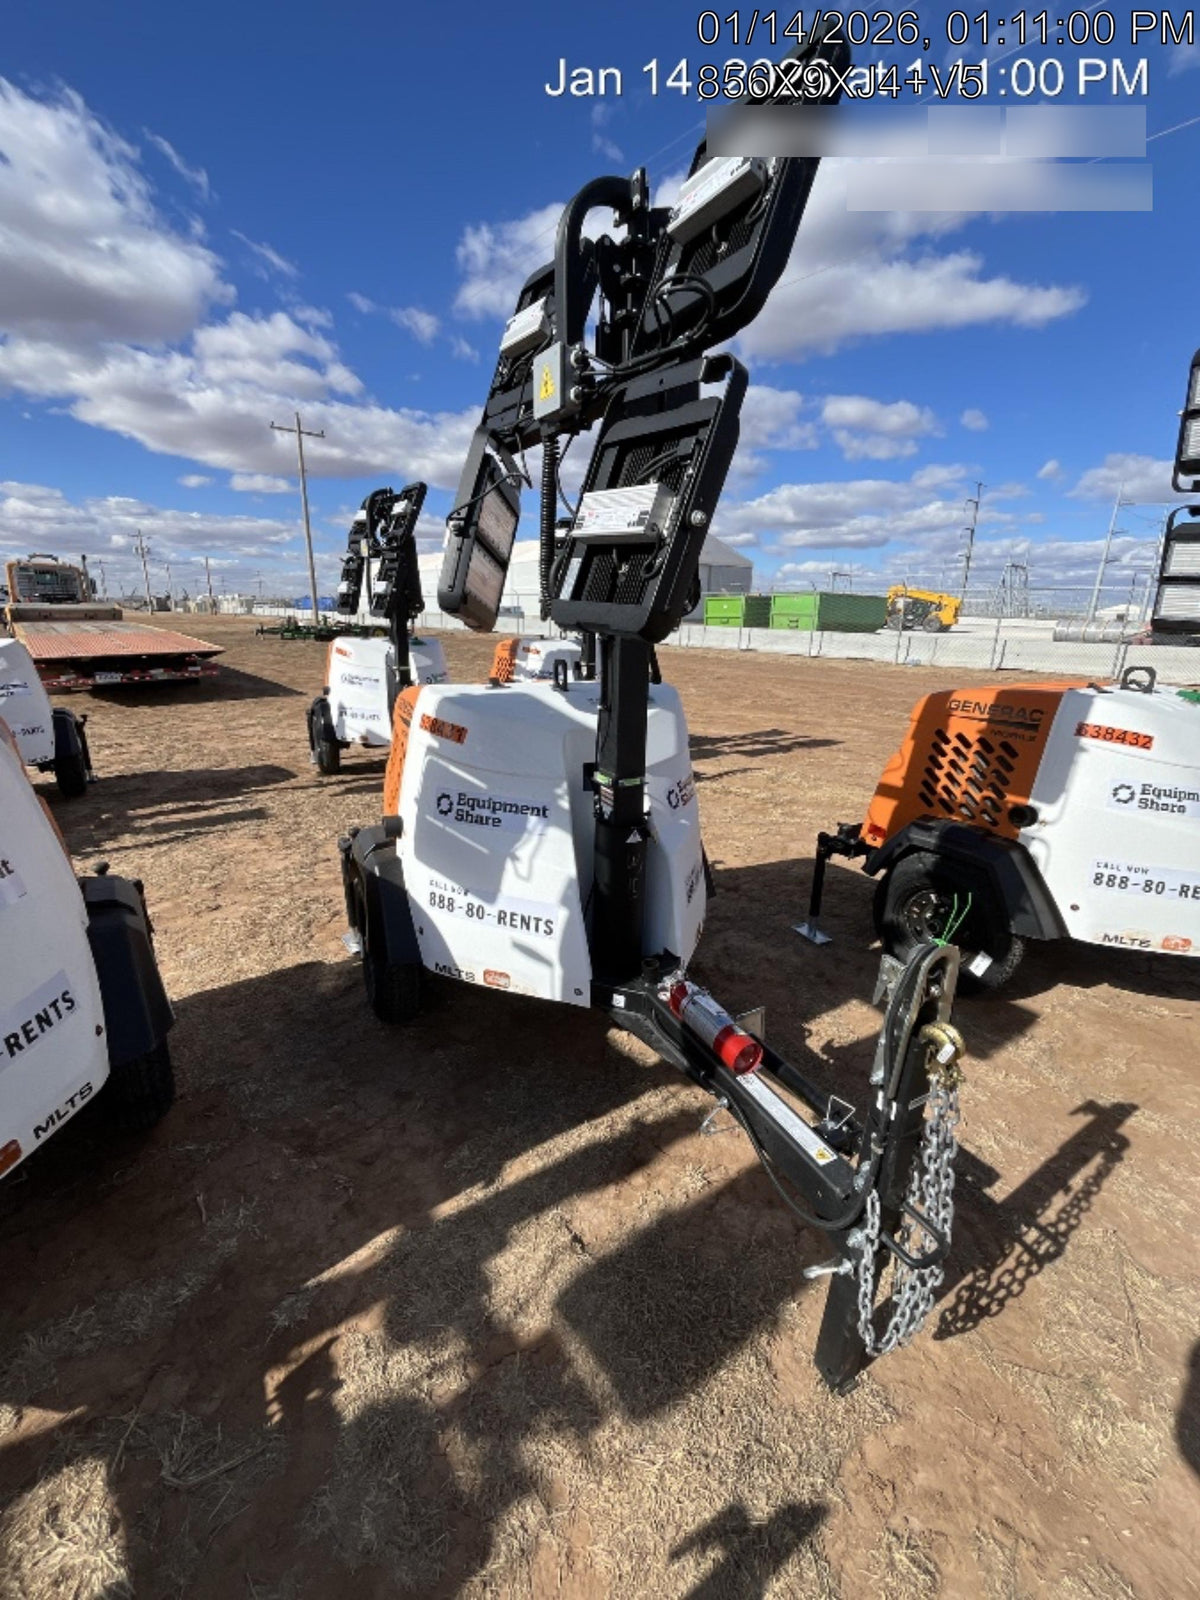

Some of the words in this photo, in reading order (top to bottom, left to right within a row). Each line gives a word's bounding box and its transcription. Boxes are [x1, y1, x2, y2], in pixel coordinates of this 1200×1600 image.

[949, 699, 1044, 722] GENERAC
[456, 792, 549, 818] Equipment
[1137, 797, 1186, 814] Share
[454, 808, 502, 828] Share
[434, 961, 476, 982] MLTS
[33, 1081, 94, 1140] MLTS
